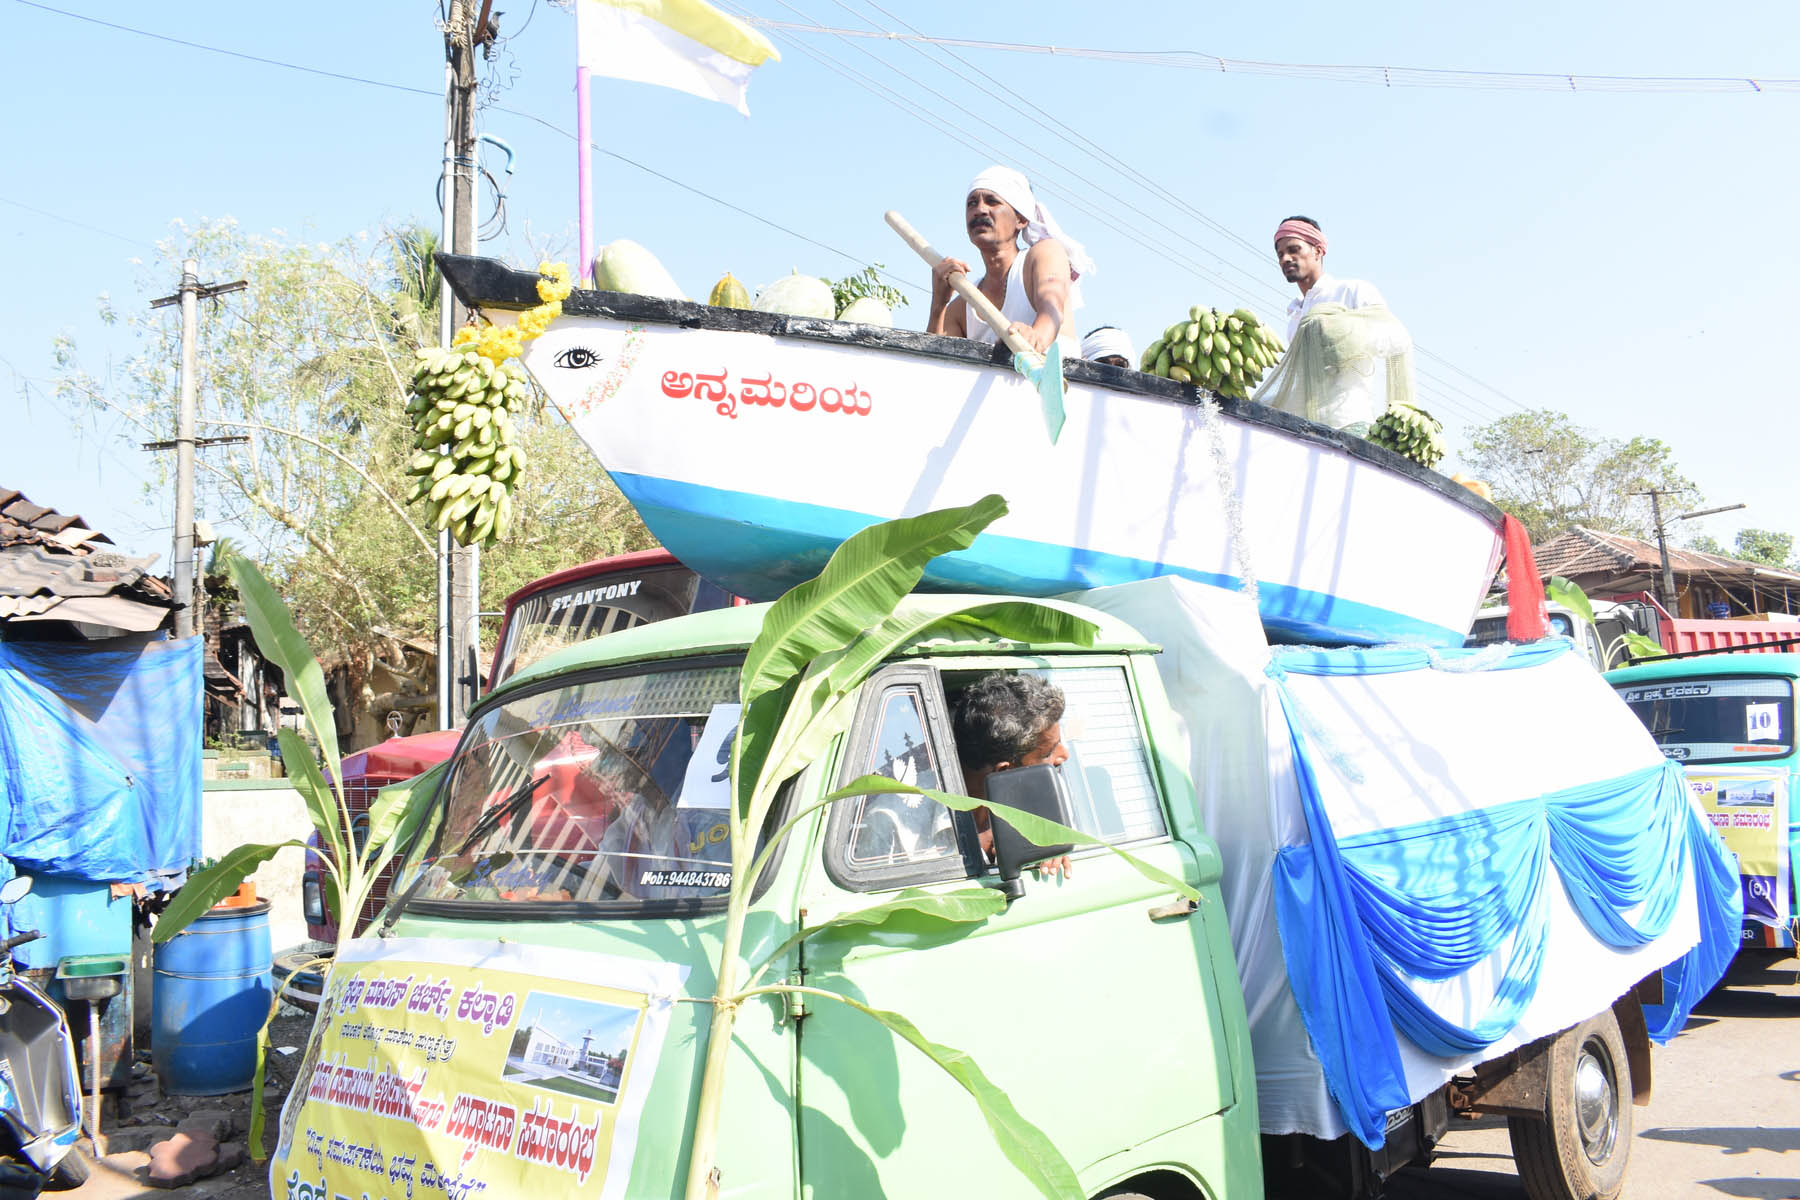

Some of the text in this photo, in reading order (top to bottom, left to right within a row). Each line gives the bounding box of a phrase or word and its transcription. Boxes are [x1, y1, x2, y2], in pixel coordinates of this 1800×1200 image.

[661, 366, 872, 420] ಅನ್ನಮರಿಯ
[1749, 711, 1771, 730] 10
[640, 871, 733, 888] Mob:944843786
[516, 1100, 600, 1183] ಸಮಾರಂಭ
